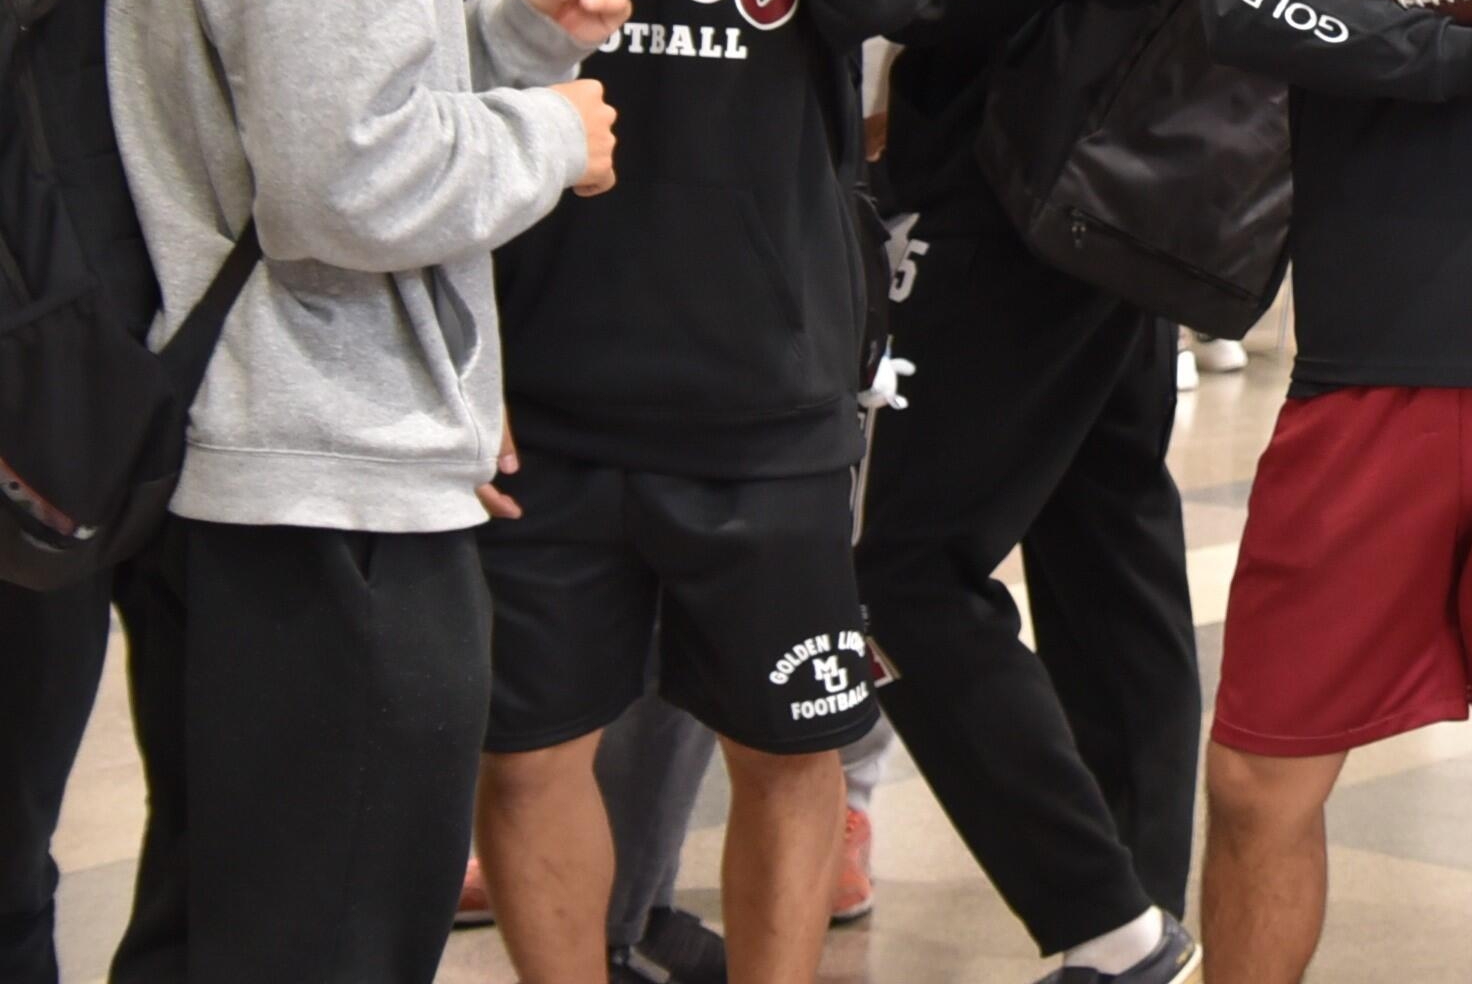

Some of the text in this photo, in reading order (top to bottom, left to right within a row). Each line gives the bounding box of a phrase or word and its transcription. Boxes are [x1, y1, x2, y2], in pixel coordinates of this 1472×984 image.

[598, 22, 748, 60] OTBALL
[769, 633, 831, 685] GOLDEN
[791, 680, 869, 721] FOOTBALL
